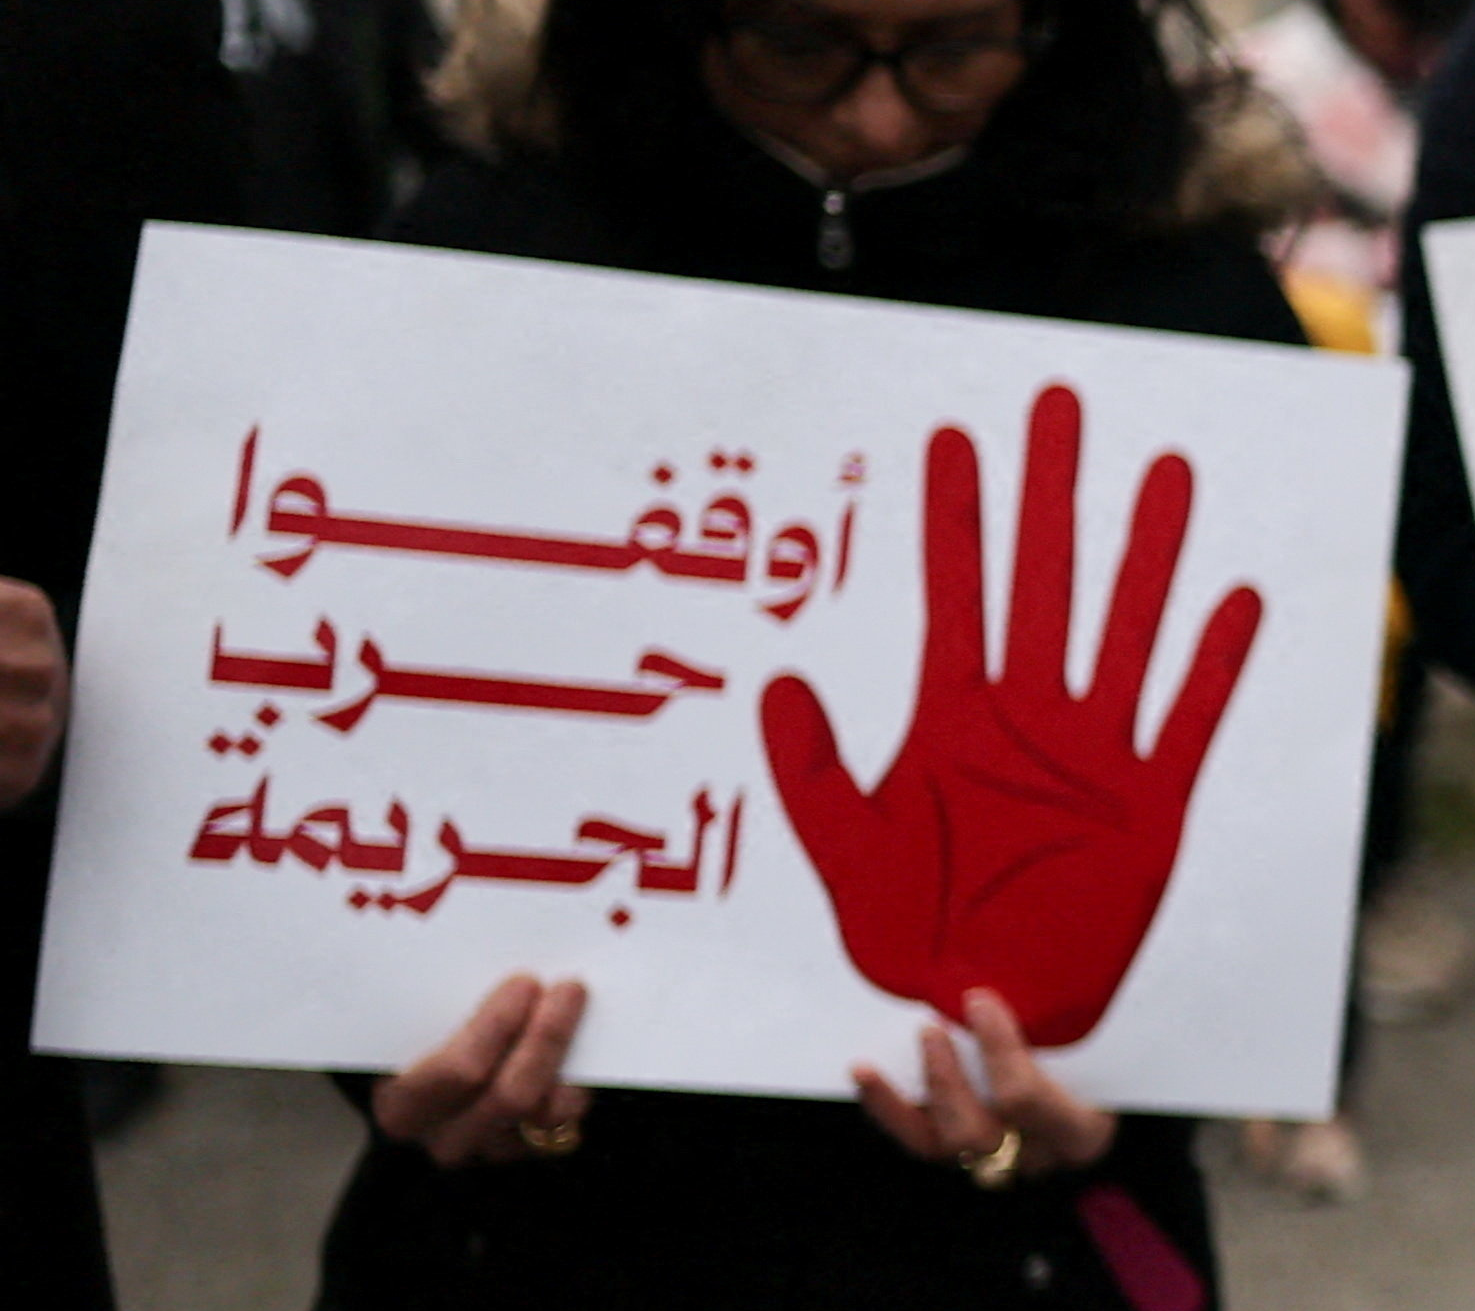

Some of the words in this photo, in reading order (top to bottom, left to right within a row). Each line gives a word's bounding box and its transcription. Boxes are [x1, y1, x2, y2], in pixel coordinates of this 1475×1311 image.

[229, 424, 867, 623] أوقفوا
[208, 618, 727, 734] حرب
[188, 733, 745, 929] الجريمة
